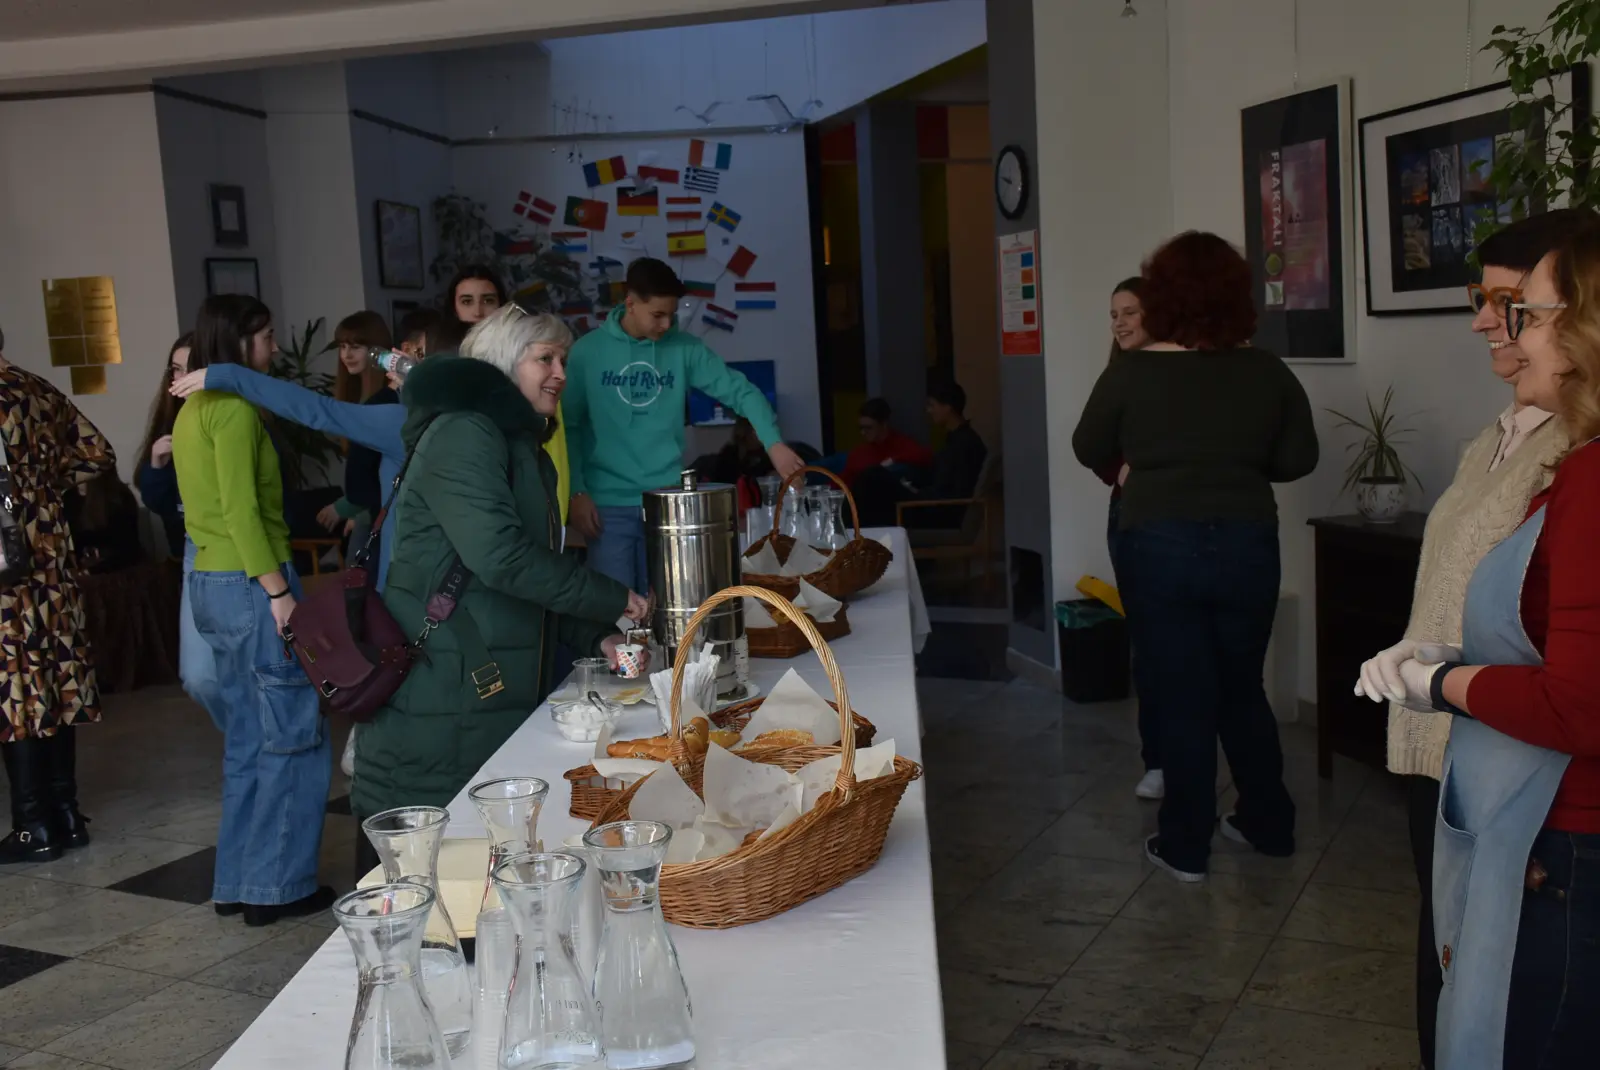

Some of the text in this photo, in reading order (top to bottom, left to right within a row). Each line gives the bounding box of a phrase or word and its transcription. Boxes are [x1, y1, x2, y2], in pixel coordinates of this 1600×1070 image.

[1270, 151, 1283, 247] FRAKTALI
[601, 370, 675, 389] Hard Rock
